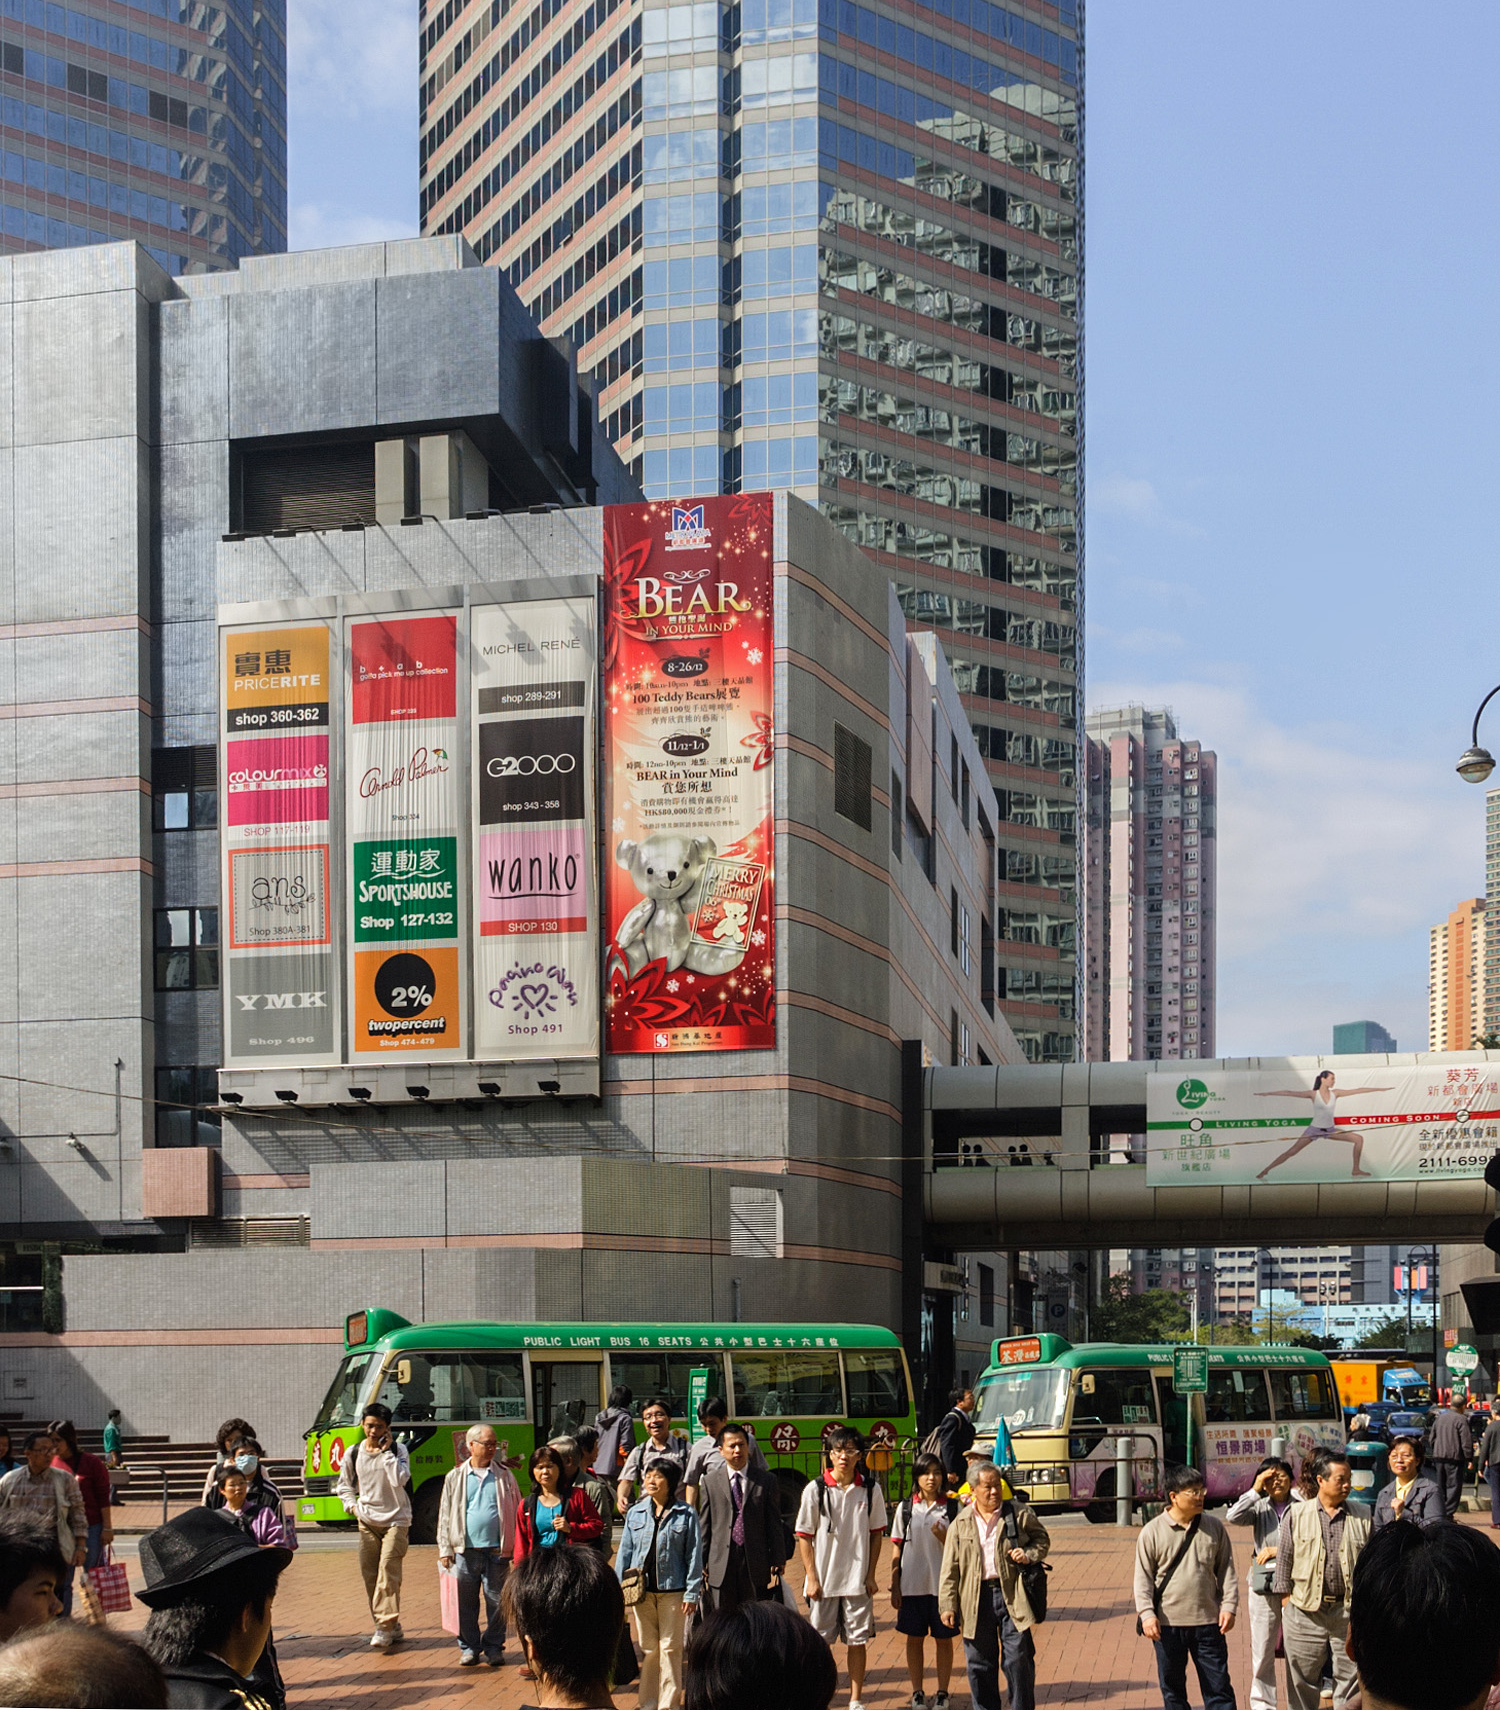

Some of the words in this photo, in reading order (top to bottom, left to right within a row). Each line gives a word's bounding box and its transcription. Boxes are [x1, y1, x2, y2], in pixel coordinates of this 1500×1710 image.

[621, 577, 752, 619] BEAR
[645, 627, 659, 637] IN
[662, 623, 695, 635] YOUR
[698, 621, 733, 633] MIND
[483, 643, 535, 656] MICHEL
[541, 636, 581, 650] RENÉ
[235, 650, 291, 677] 實惠
[667, 661, 703, 672] 8-26/12
[234, 674, 321, 692] PRICERITE
[502, 693, 523, 704] shop
[525, 690, 561, 702] 289-291
[633, 694, 650, 704] 100
[652, 692, 684, 704] Teddy
[236, 713, 267, 726] shop
[270, 708, 319, 723] 360-362
[360, 767, 405, 798] Arnold
[408, 747, 449, 781] Palmer
[487, 753, 576, 778] G2000
[637, 770, 668, 781] BEAR
[670, 770, 680, 780] in
[682, 769, 708, 779] Your
[709, 767, 738, 778] Mind
[503, 803, 522, 813] shop
[244, 826, 271, 837] SHOP
[275, 824, 310, 835] 117-119
[371, 848, 441, 872] 運動家
[489, 852, 577, 893] wanko
[711, 864, 758, 884] MERRY
[252, 875, 306, 901] ans
[359, 880, 453, 907] SPORTSHOUSE
[706, 879, 755, 902] CHRISTMAS
[360, 916, 395, 930] Shop
[401, 912, 454, 927] 127-132
[508, 922, 537, 932] SHOP
[540, 921, 558, 931] 130
[249, 927, 271, 937] Shop
[236, 991, 328, 1011] YMK
[391, 985, 433, 1007] 2%
[368, 1016, 446, 1034] twopercent
[508, 1025, 538, 1036] Shop
[542, 1024, 563, 1033] 491
[249, 1038, 282, 1047] Shop
[287, 1036, 315, 1045] 496
[379, 1039, 400, 1048] Shop
[401, 1038, 435, 1046] 474-479
[1446, 1068, 1479, 1084] 葵芳
[1427, 1082, 1499, 1097] 新都會廣場
[1350, 1116, 1400, 1124] COMING
[1406, 1114, 1440, 1122] SOON
[1180, 1133, 1213, 1148] 旺角
[1162, 1148, 1231, 1161] 新世紀廣場
[524, 1337, 562, 1347] PUBLIC
[570, 1337, 601, 1347] LIGHT
[610, 1337, 631, 1347] BUS
[638, 1337, 650, 1347] 16
[658, 1337, 693, 1347] SEATS
[699, 1336, 840, 1347] 公共小型巴士十六座位
[1147, 1354, 1170, 1362] PUBLIC
[1452, 1384, 1466, 1394] 407
[1215, 1439, 1267, 1455] 恒景商場
